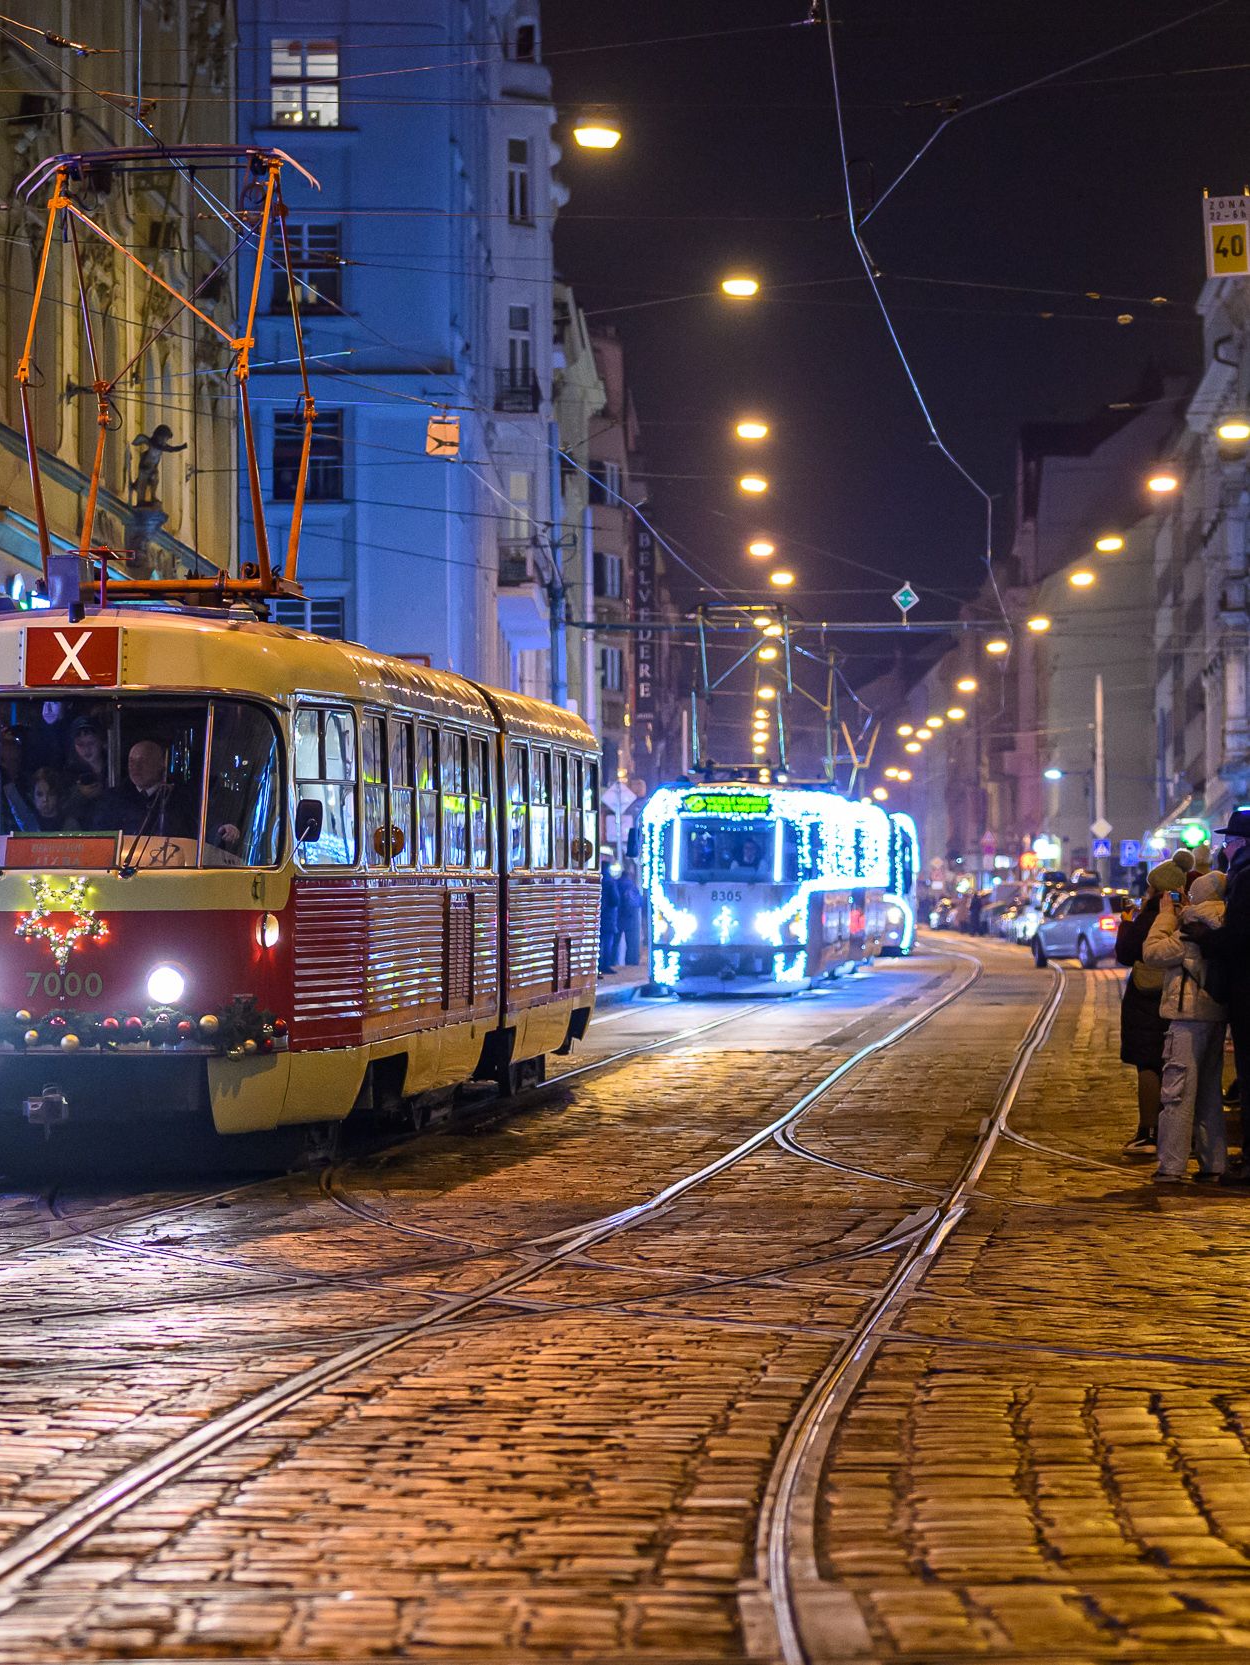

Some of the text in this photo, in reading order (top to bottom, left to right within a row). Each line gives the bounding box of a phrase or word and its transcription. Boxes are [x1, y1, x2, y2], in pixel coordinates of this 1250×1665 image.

[1215, 235, 1244, 258] 40
[638, 532, 651, 699] BELVEDERE
[51, 631, 93, 681] X
[711, 890, 742, 902] 8305
[25, 972, 103, 997] 7000
